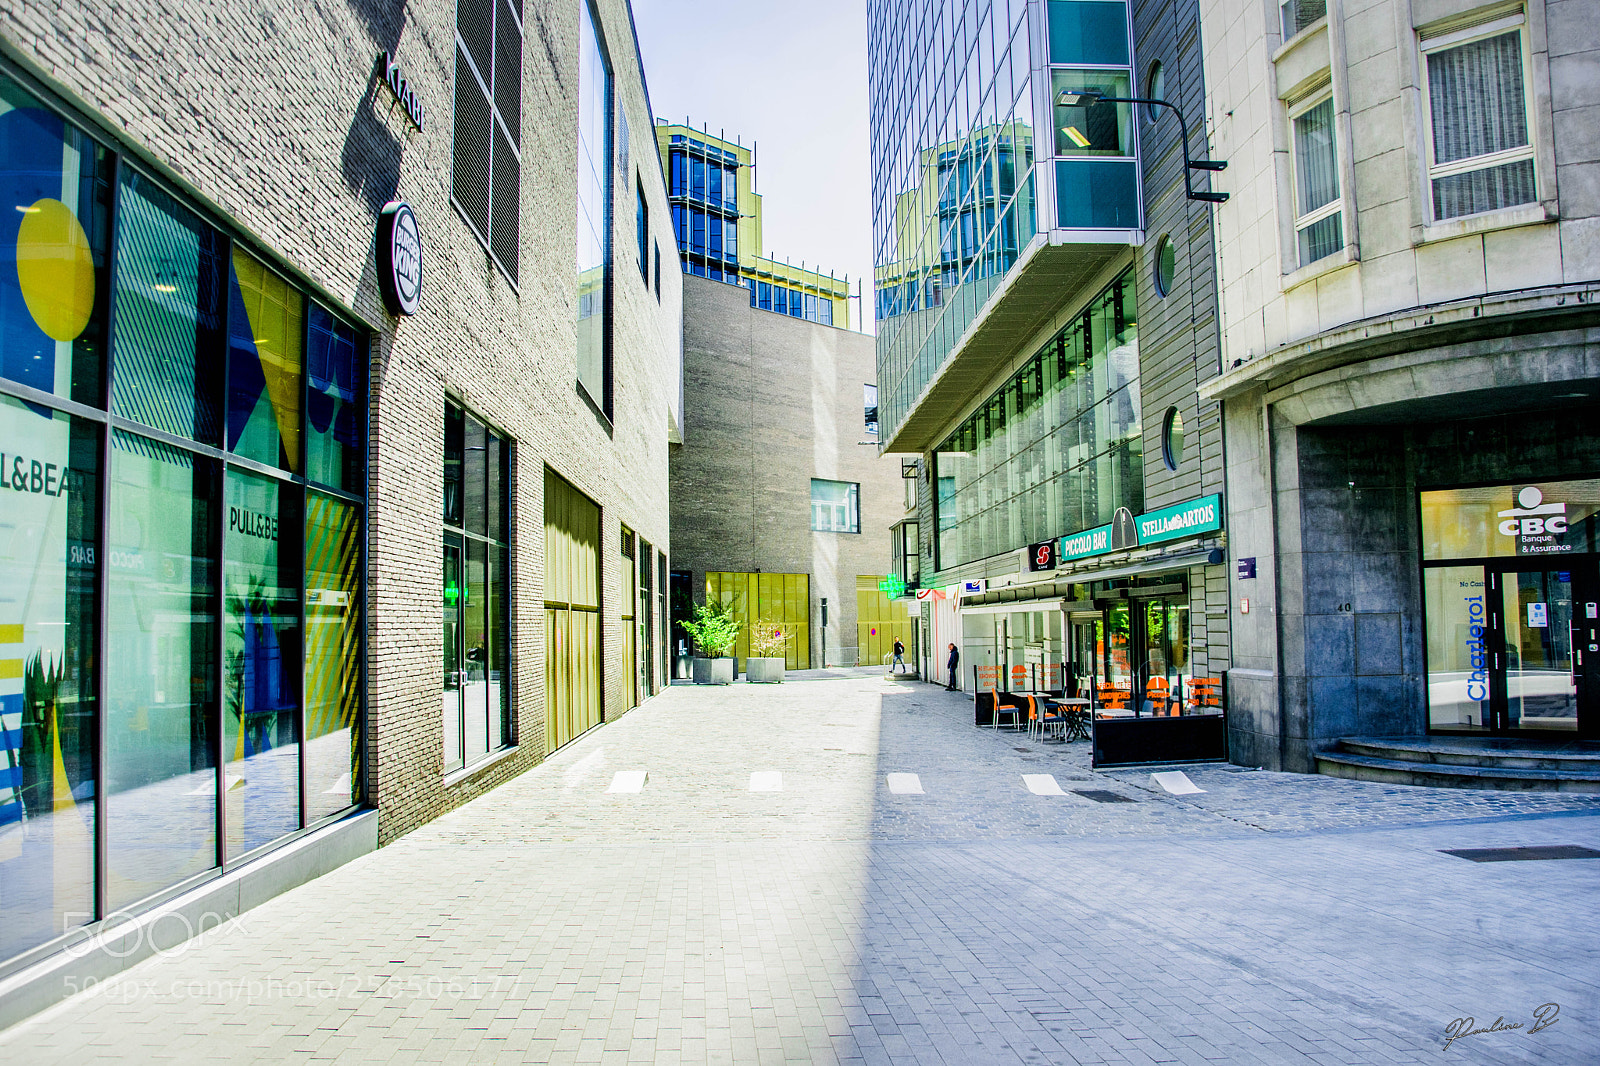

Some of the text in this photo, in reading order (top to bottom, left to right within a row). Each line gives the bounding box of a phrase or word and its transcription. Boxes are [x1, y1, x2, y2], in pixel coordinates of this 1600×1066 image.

[384, 52, 424, 132] KIABI
[396, 225, 420, 263] BURGER
[395, 245, 420, 287] KING
[1142, 504, 1214, 537] STELLA ARTOIS
[1498, 516, 1567, 536] CBC
[1065, 531, 1107, 556] PICCOLO BAR
[1521, 535, 1553, 543] Banque
[1522, 544, 1572, 553] & Assurance
[1337, 602, 1351, 612] 40
[1464, 595, 1487, 702] Charleroi
